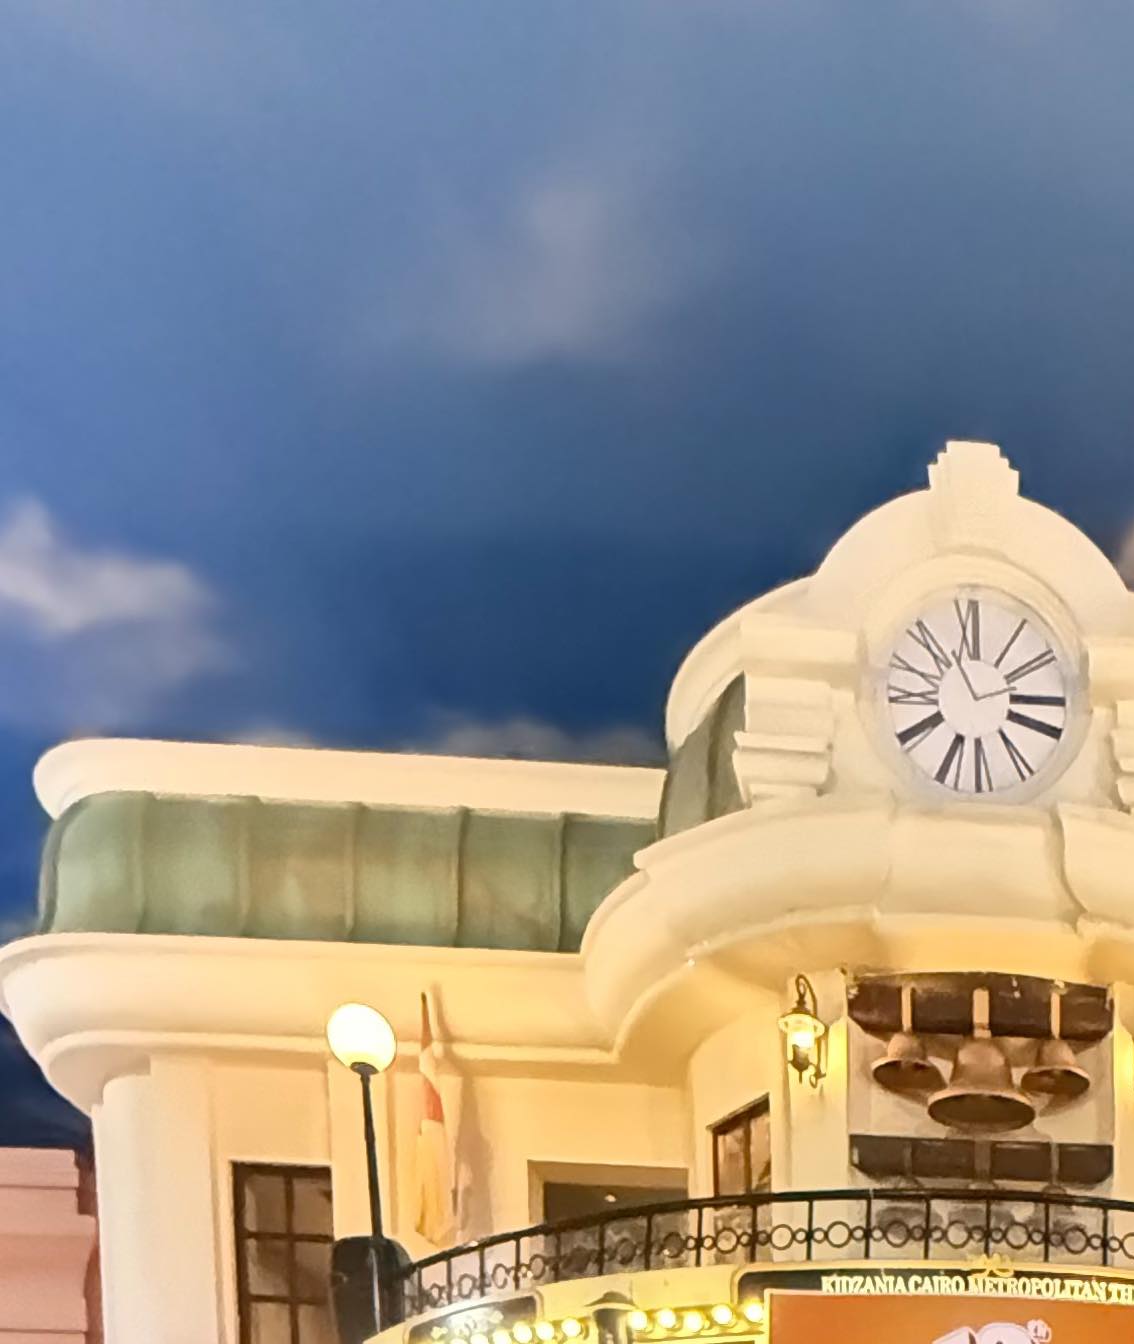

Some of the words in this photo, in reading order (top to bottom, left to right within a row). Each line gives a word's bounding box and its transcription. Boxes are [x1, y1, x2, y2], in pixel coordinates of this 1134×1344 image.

[820, 1275, 905, 1294] KIDZANIA
[908, 1275, 965, 1294] CAIRO
[967, 1276, 1107, 1303] METROPOLITAN
